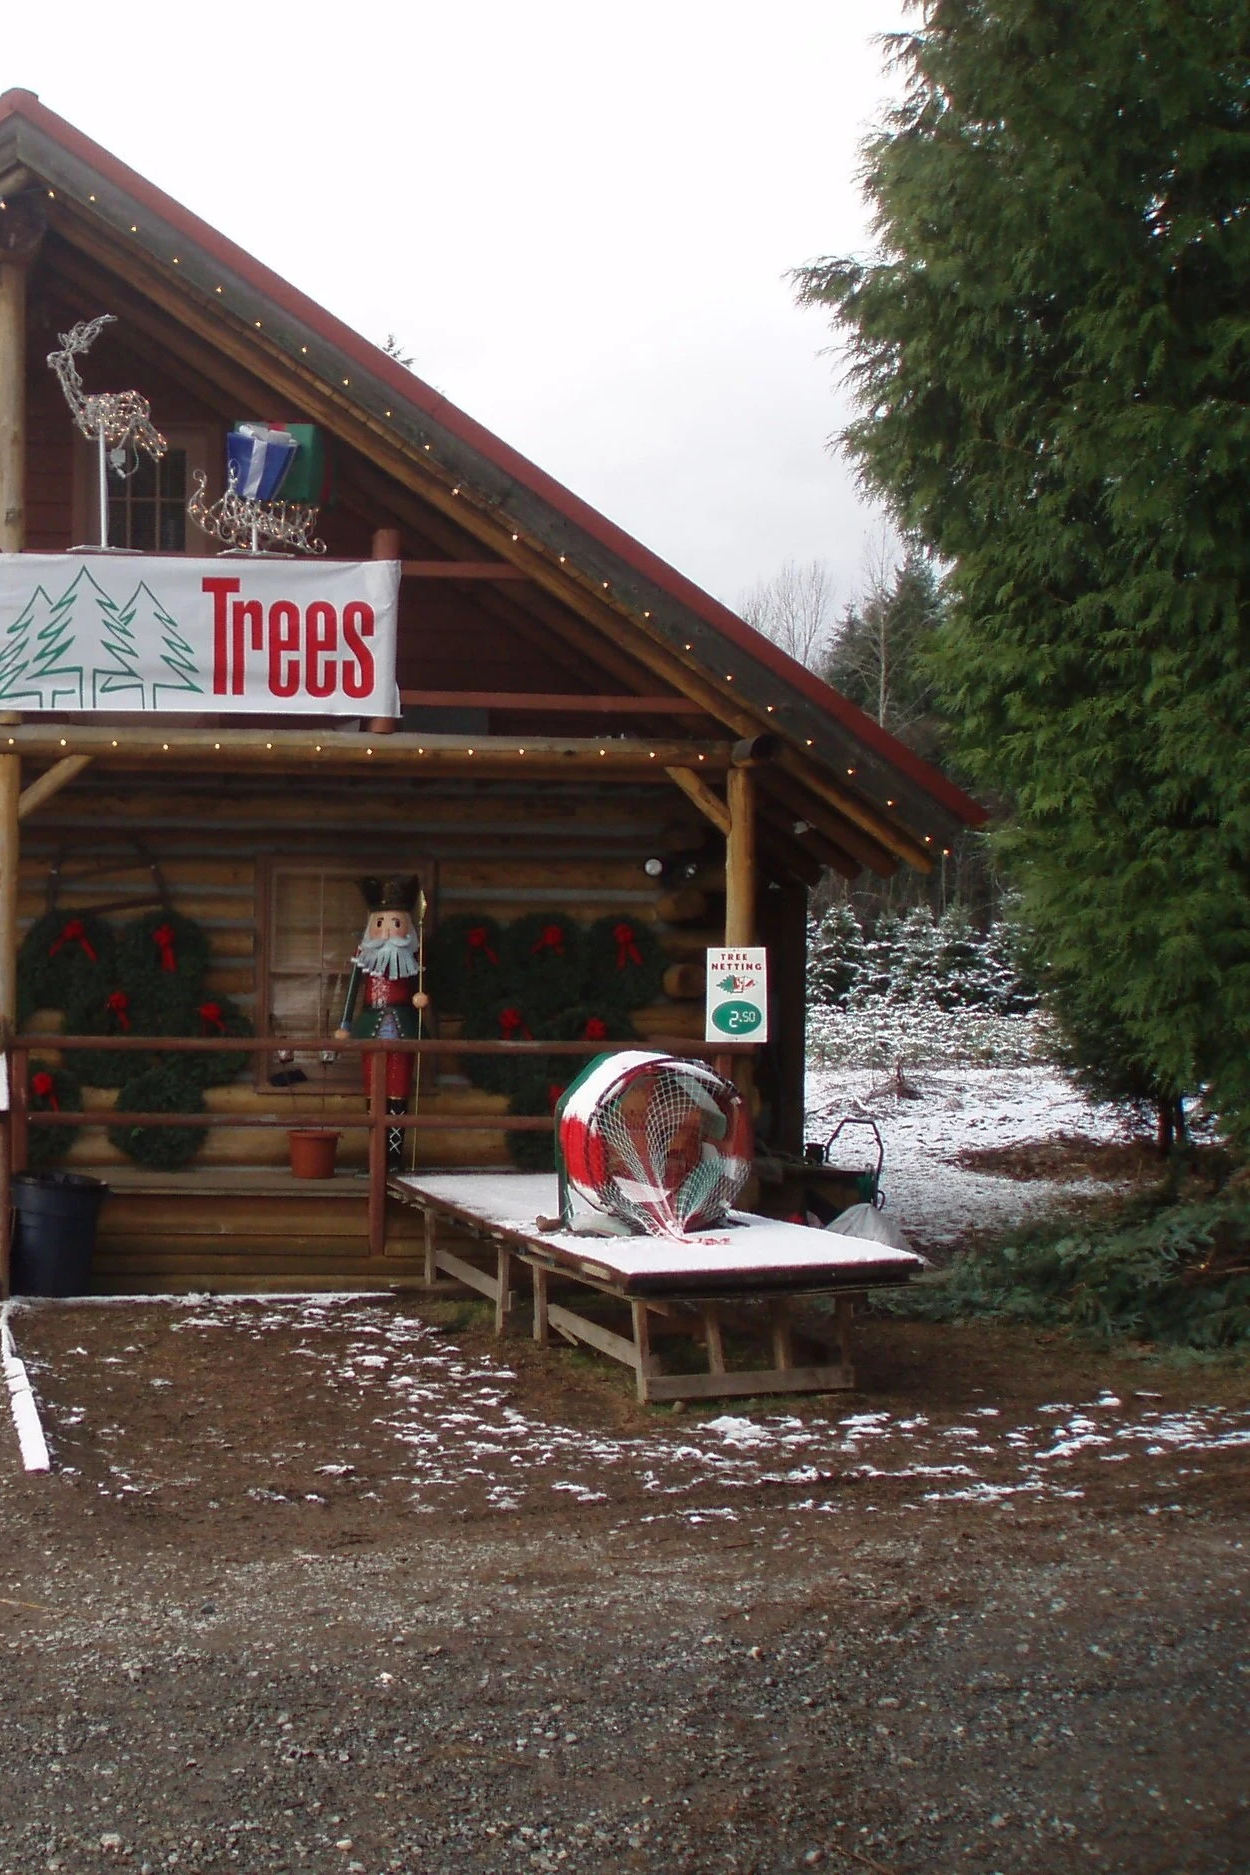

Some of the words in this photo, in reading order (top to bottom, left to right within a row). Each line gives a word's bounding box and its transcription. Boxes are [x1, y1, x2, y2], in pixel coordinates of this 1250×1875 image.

[201, 576, 375, 699] Trees
[720, 953, 748, 961] TREE
[711, 963, 762, 971] NETTING
[729, 1010, 756, 1028] 2.50
